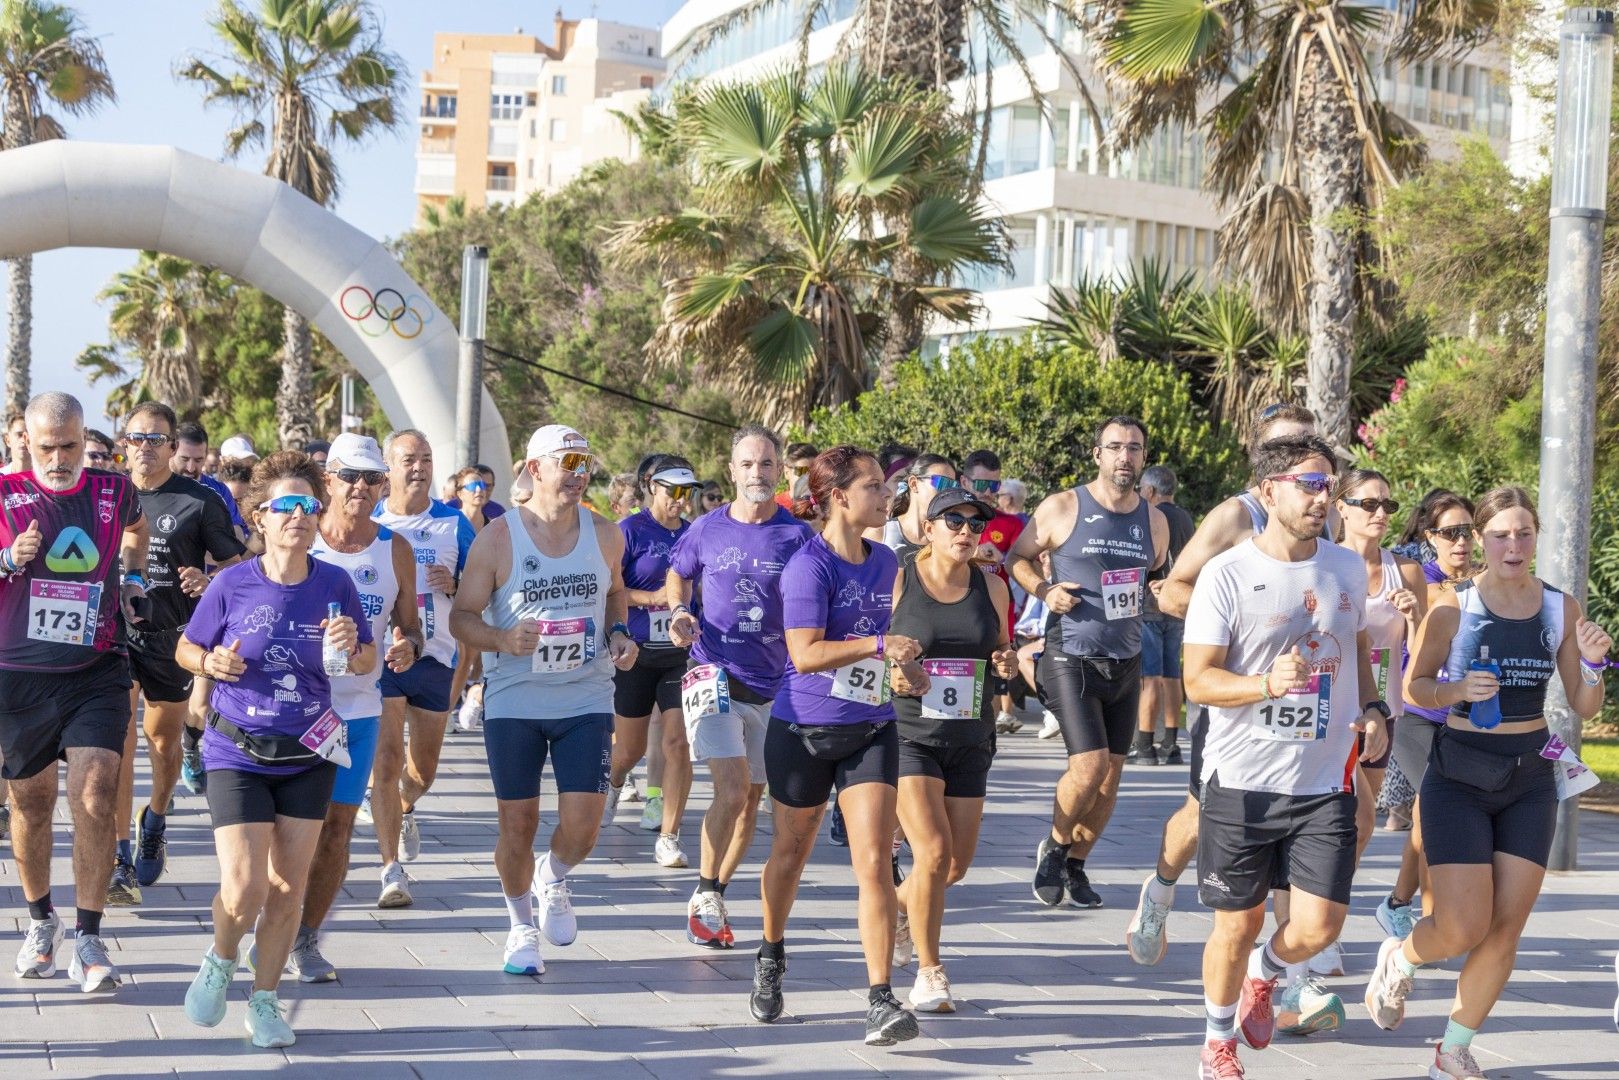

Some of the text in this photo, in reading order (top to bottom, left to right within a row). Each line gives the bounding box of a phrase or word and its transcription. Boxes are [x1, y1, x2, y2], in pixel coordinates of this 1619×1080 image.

[1081, 546, 1148, 560] PUERTO TORREVIEJA
[1107, 540, 1143, 551] ATLETISMO
[523, 573, 597, 591] Club Atletismo
[519, 582, 598, 604] Torrevieja
[1108, 591, 1136, 608] 191
[35, 608, 82, 631] 173
[87, 608, 97, 627] KM
[426, 610, 435, 625] KM
[538, 643, 581, 662] 172
[586, 636, 594, 653] KM
[1501, 659, 1555, 669] ATLETISMO
[848, 666, 876, 691] 52
[718, 681, 728, 697] KM
[942, 687, 958, 707] 8
[976, 680, 983, 697] KM
[1259, 705, 1314, 728] 152
[1319, 699, 1328, 730] 7 KM
